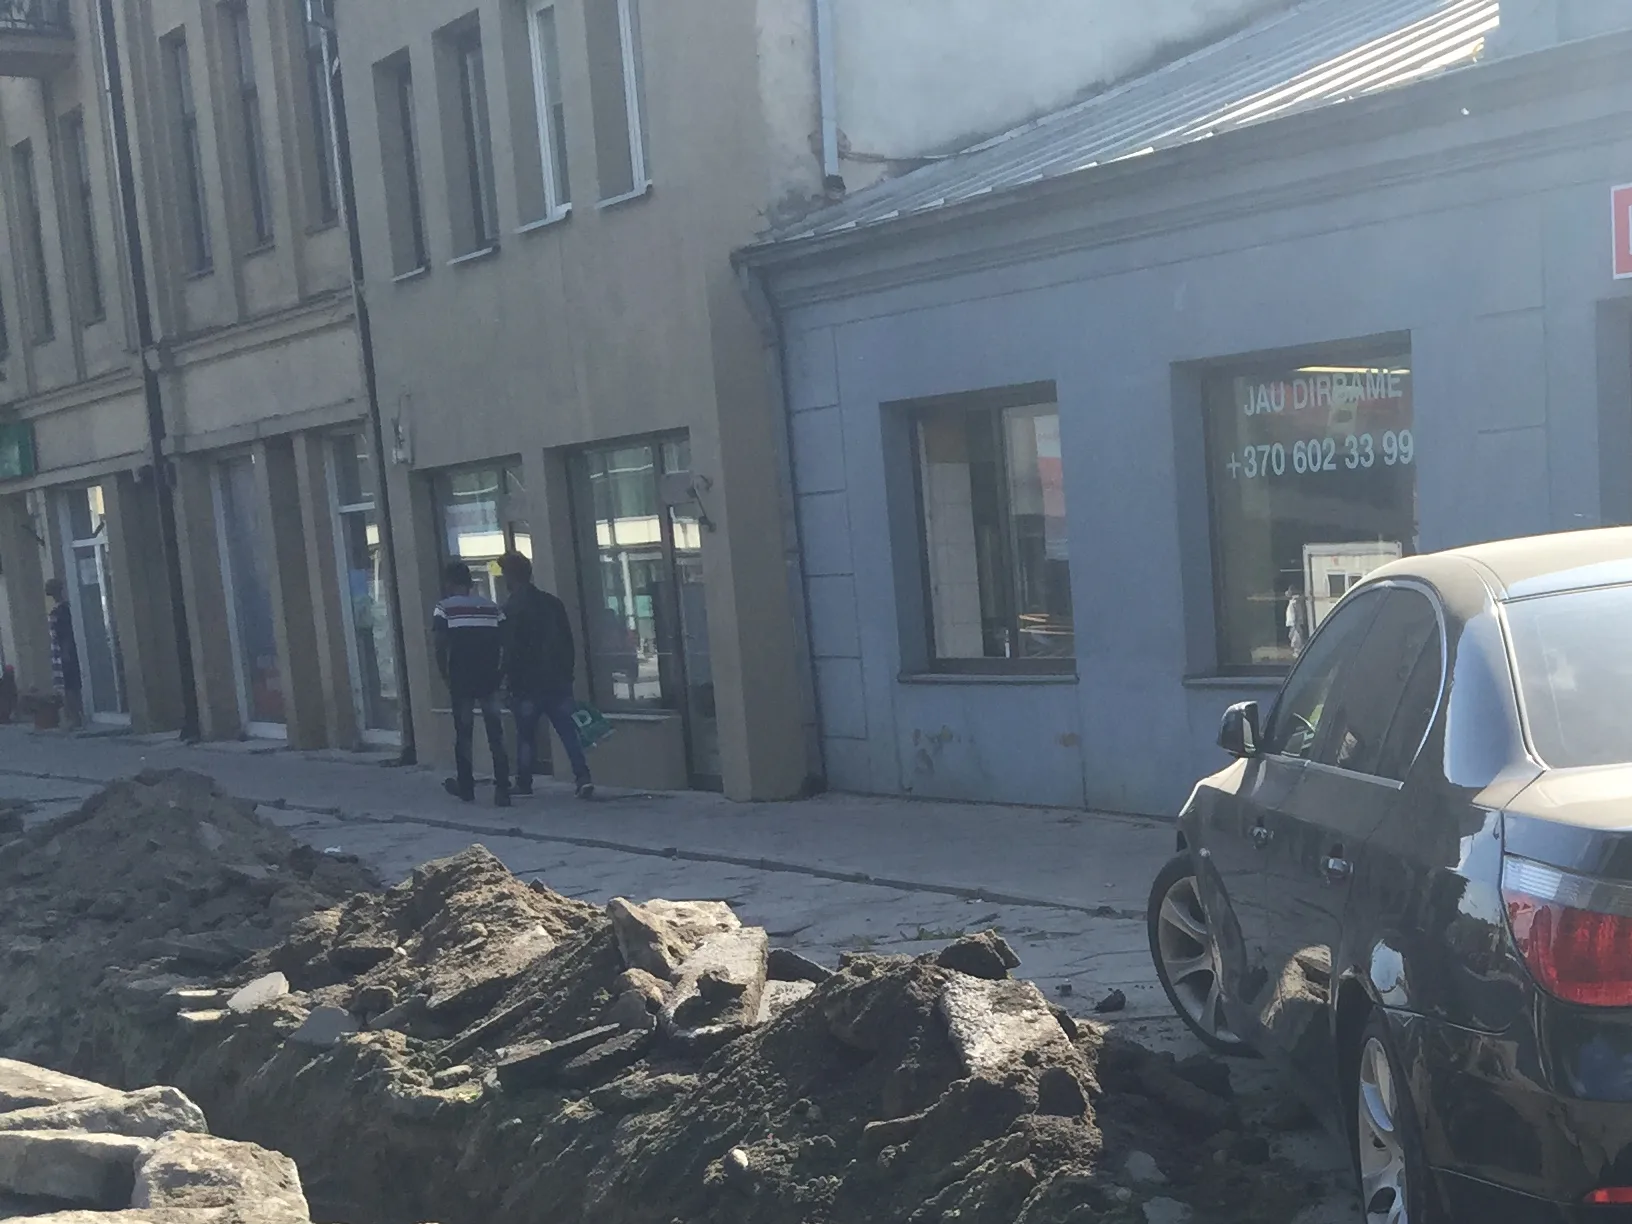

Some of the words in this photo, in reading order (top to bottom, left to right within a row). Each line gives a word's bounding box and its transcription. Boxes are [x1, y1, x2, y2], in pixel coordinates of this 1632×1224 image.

[1244, 380, 1286, 416] JAU
[1292, 371, 1403, 409] DIRBAME
[1226, 442, 1286, 479] +370
[1292, 437, 1337, 474] 602
[1344, 432, 1376, 470] 33
[1382, 429, 1414, 466] 99
